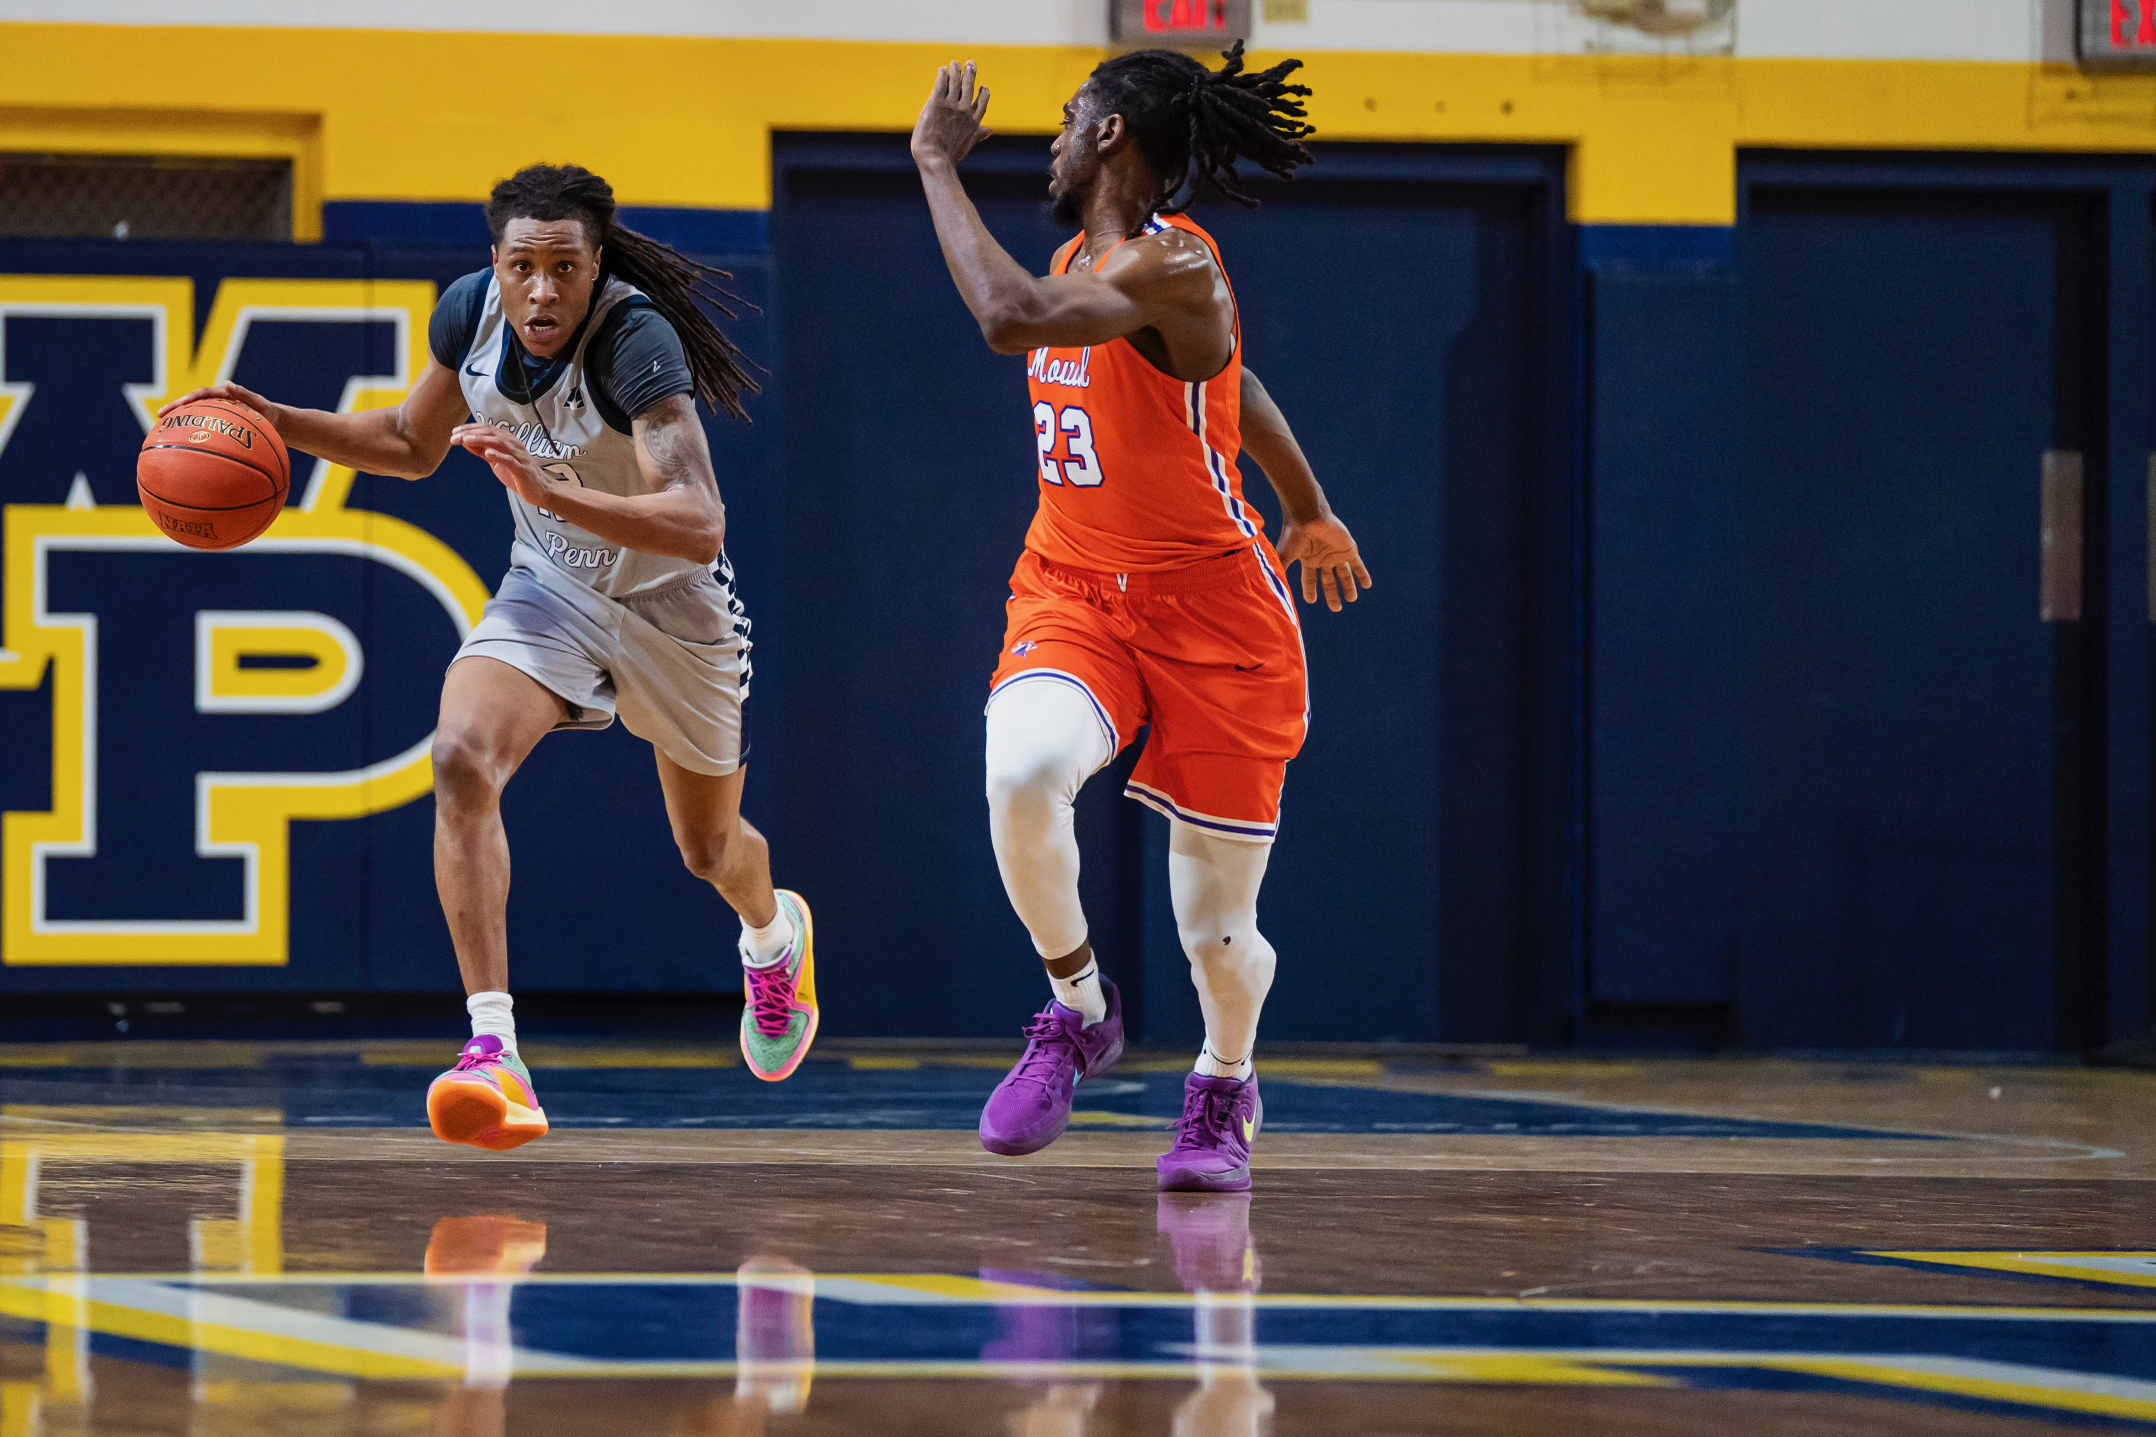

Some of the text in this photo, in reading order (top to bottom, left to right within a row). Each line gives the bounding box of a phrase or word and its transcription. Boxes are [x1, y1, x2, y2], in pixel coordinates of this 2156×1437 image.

[159, 414, 257, 450] SPALDING
[1033, 400, 1105, 488] 23
[158, 510, 219, 541] NAIA
[544, 529, 617, 569] Penn
